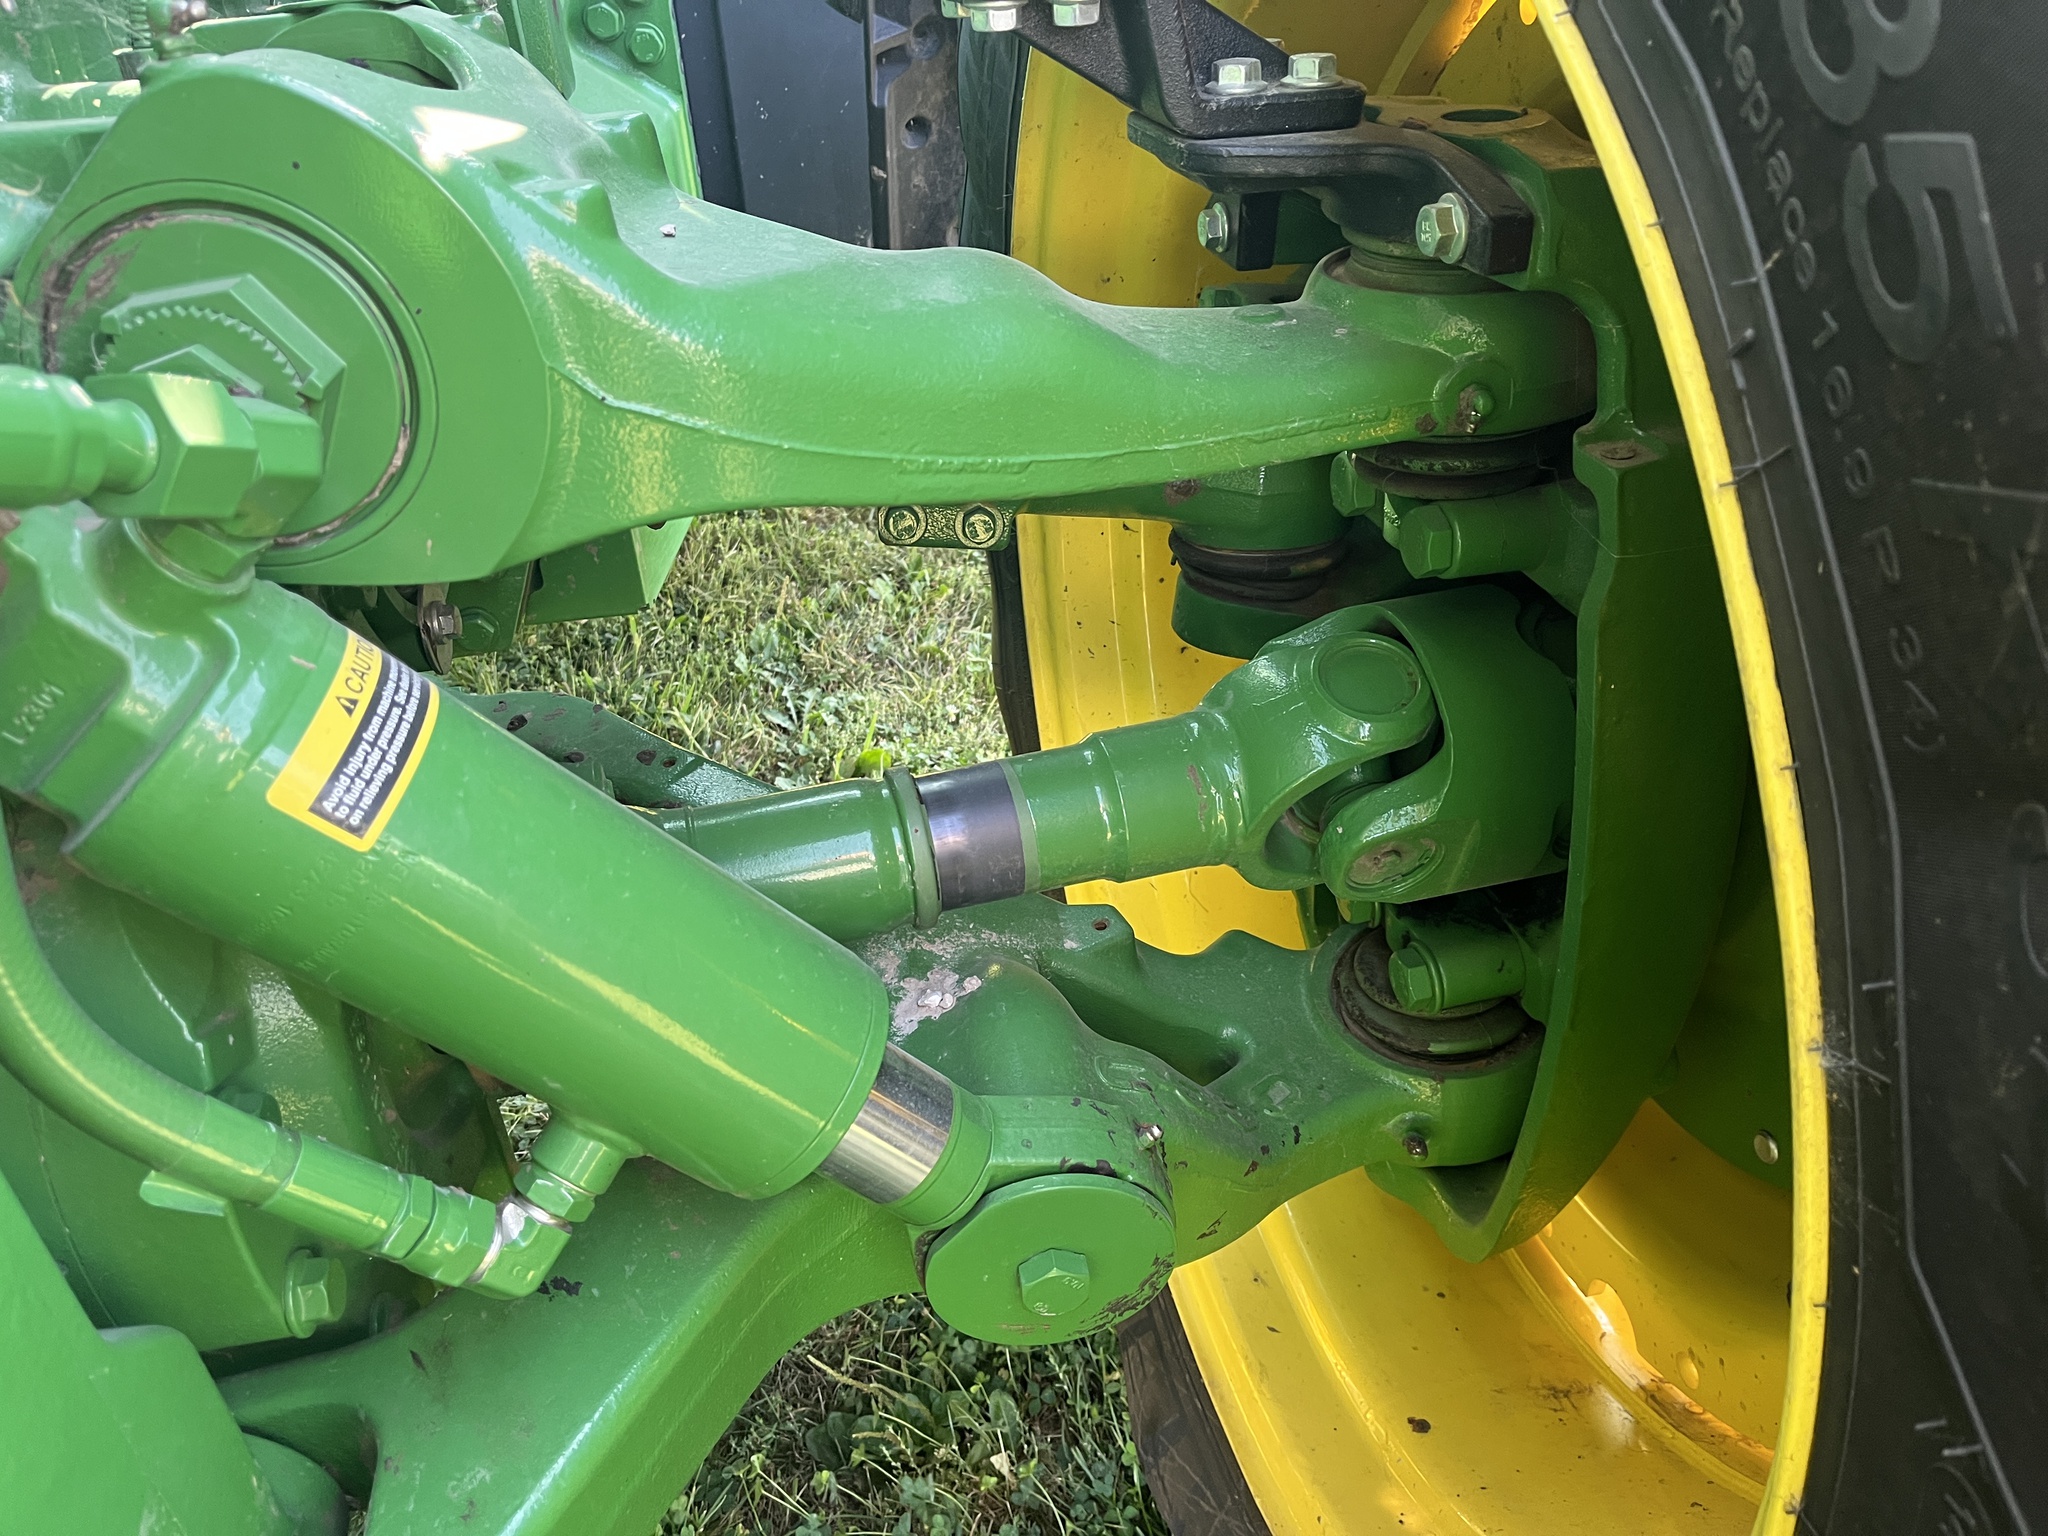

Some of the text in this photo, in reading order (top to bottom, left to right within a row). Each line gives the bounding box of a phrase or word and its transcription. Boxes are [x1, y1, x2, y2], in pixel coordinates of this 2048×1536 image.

[345, 639, 374, 694] CAUTIO
[322, 774, 351, 813] Avoid
[362, 715, 383, 742] from
[376, 680, 397, 717] machine
[334, 805, 350, 819] to
[342, 777, 366, 806] fluid
[360, 747, 383, 780] under
[377, 706, 402, 750] pressure.
[349, 808, 365, 825] on
[359, 762, 394, 810] relieving
[385, 720, 411, 766] pressure
